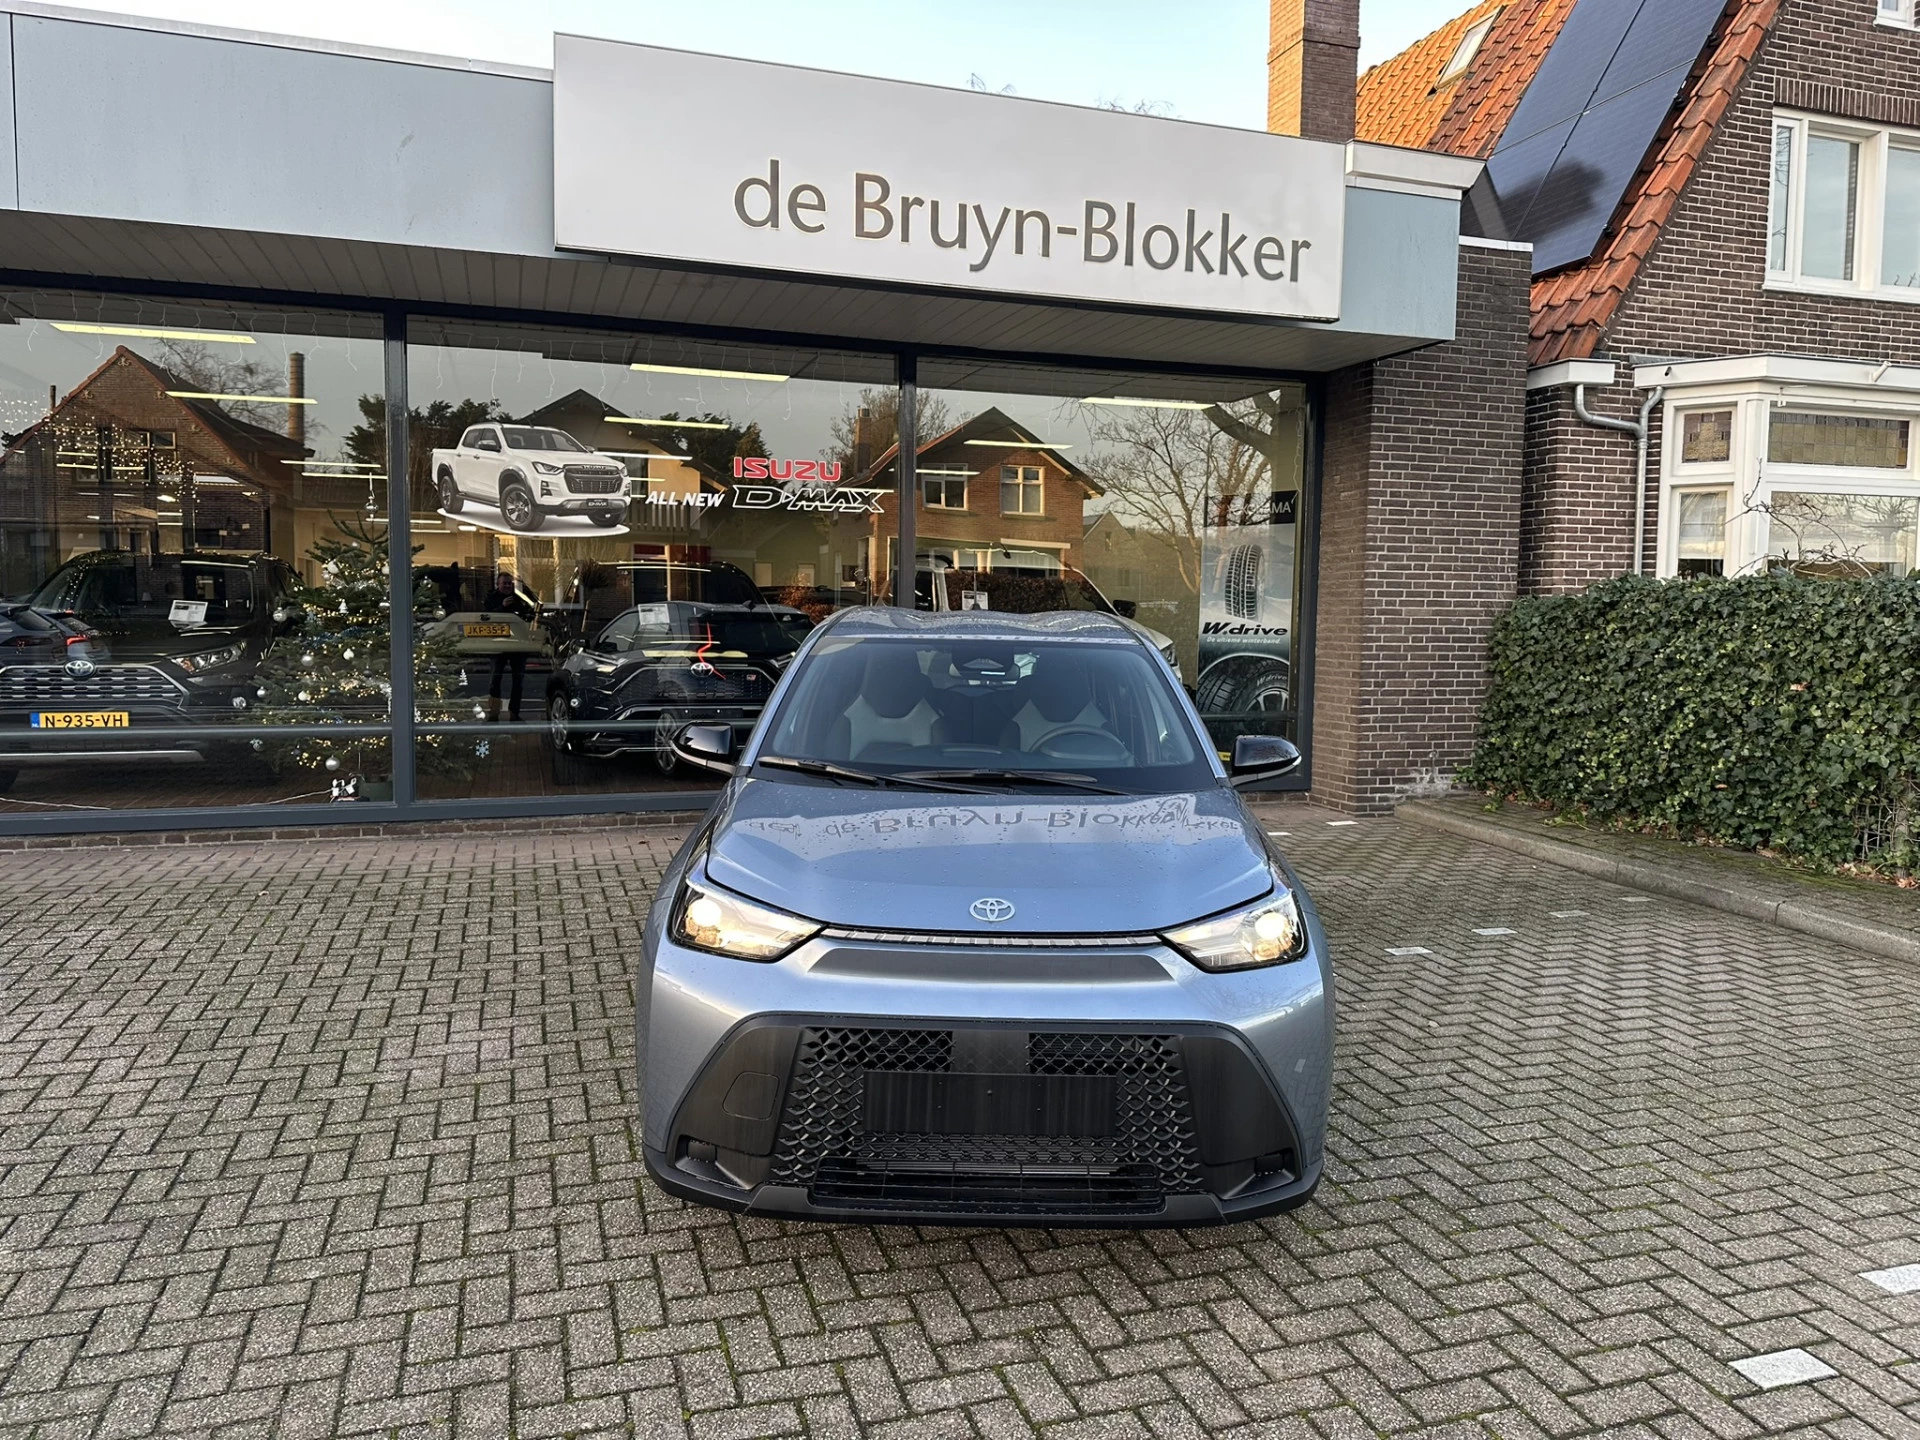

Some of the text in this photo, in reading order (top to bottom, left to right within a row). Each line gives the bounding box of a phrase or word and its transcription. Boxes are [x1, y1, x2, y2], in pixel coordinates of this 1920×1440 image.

[733, 159, 1312, 283] de Bruyn-Blokker
[733, 456, 842, 482] ISUZU
[645, 491, 679, 506] ALL
[682, 492, 726, 508] NEW
[1202, 621, 1288, 636] W.drive
[45, 714, 123, 728] N-935-VH
